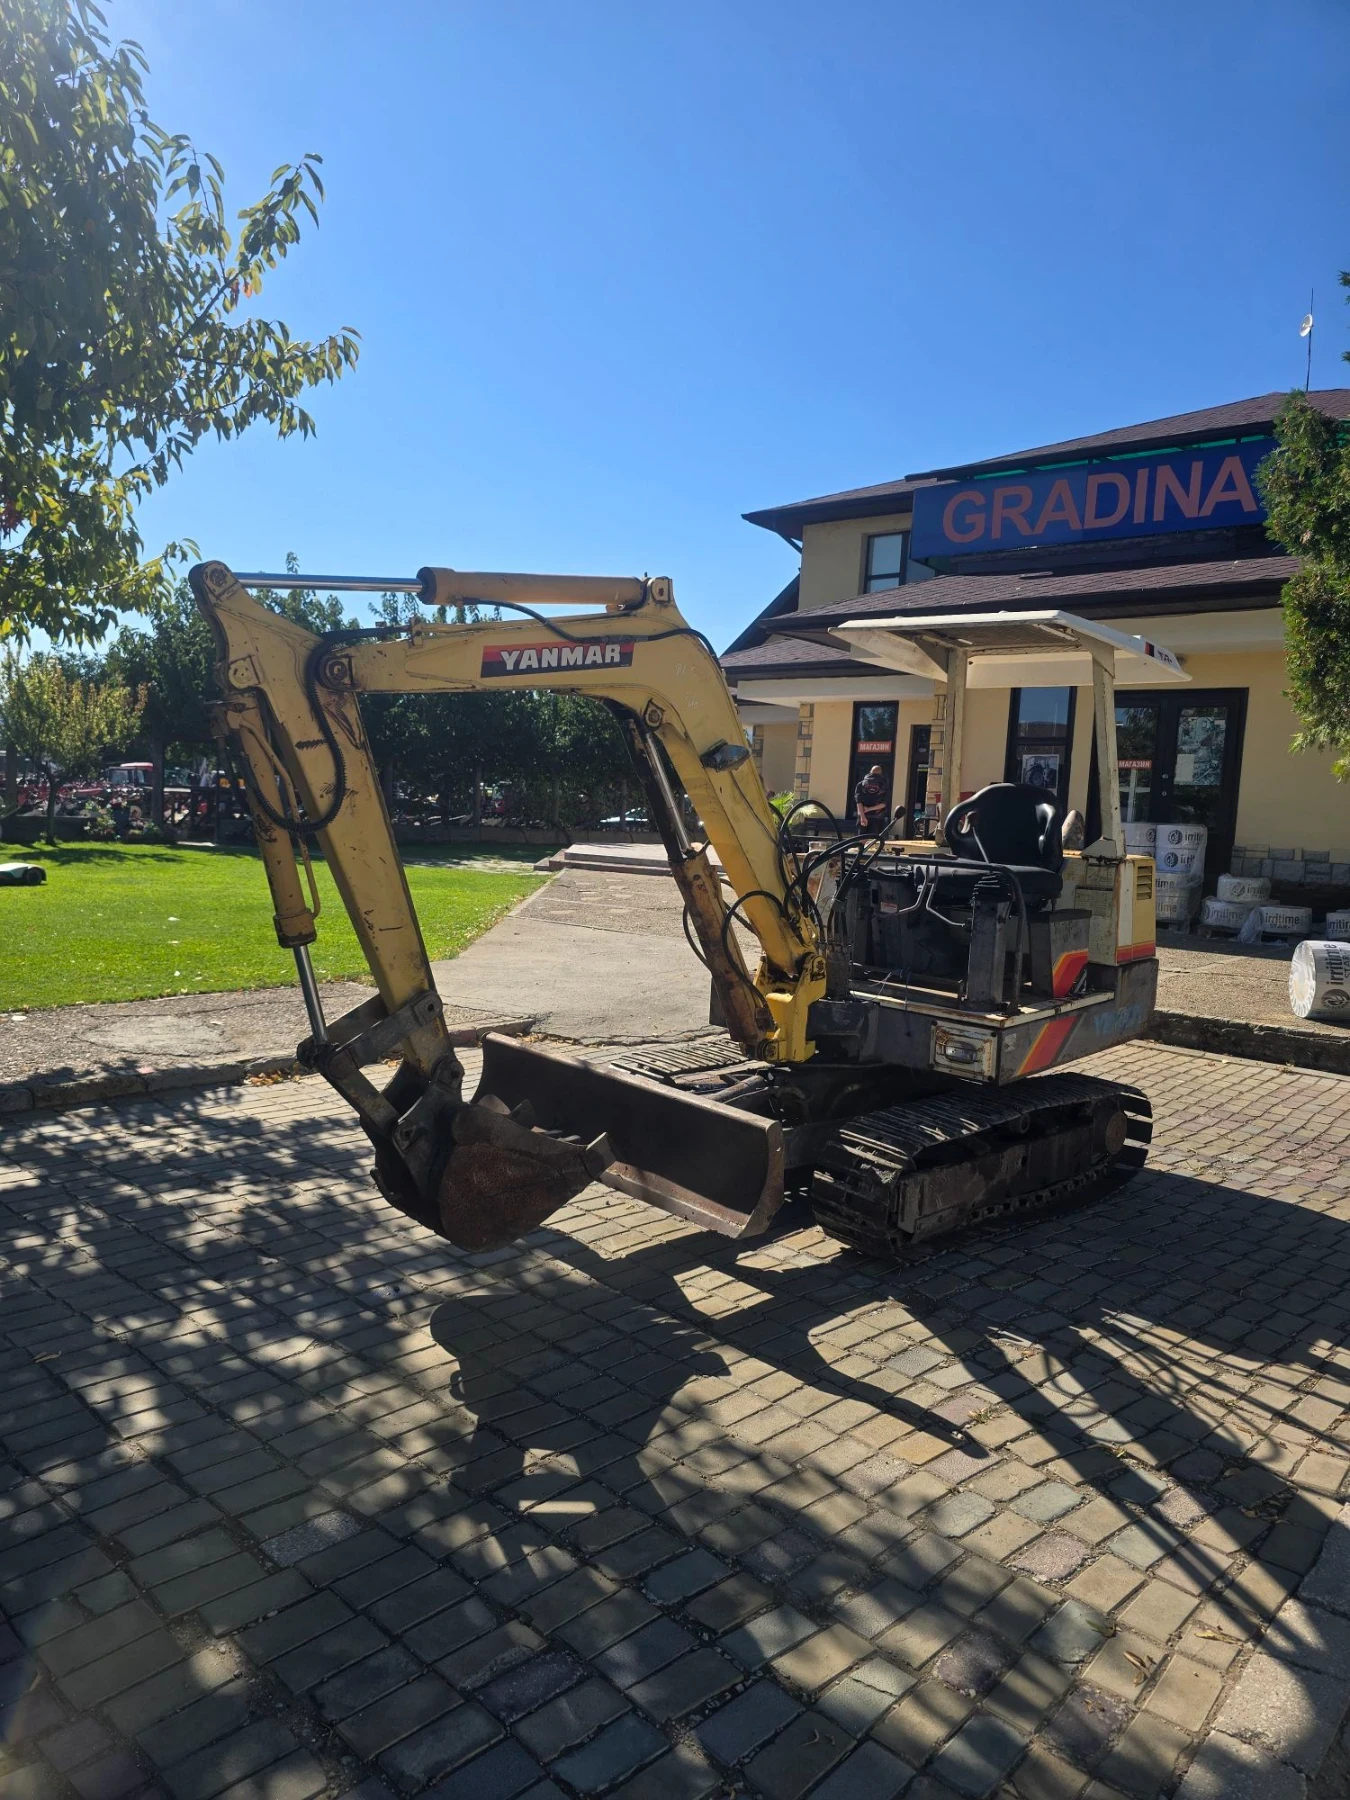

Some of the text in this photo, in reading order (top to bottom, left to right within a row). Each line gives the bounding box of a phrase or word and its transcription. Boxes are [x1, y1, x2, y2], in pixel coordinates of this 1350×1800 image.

[942, 455, 1258, 543] GRADINA
[499, 644, 621, 671] YANMAR
[859, 742, 890, 752] МАГАЗИН
[1265, 912, 1300, 925] irritime
[1323, 944, 1344, 985] irritime
